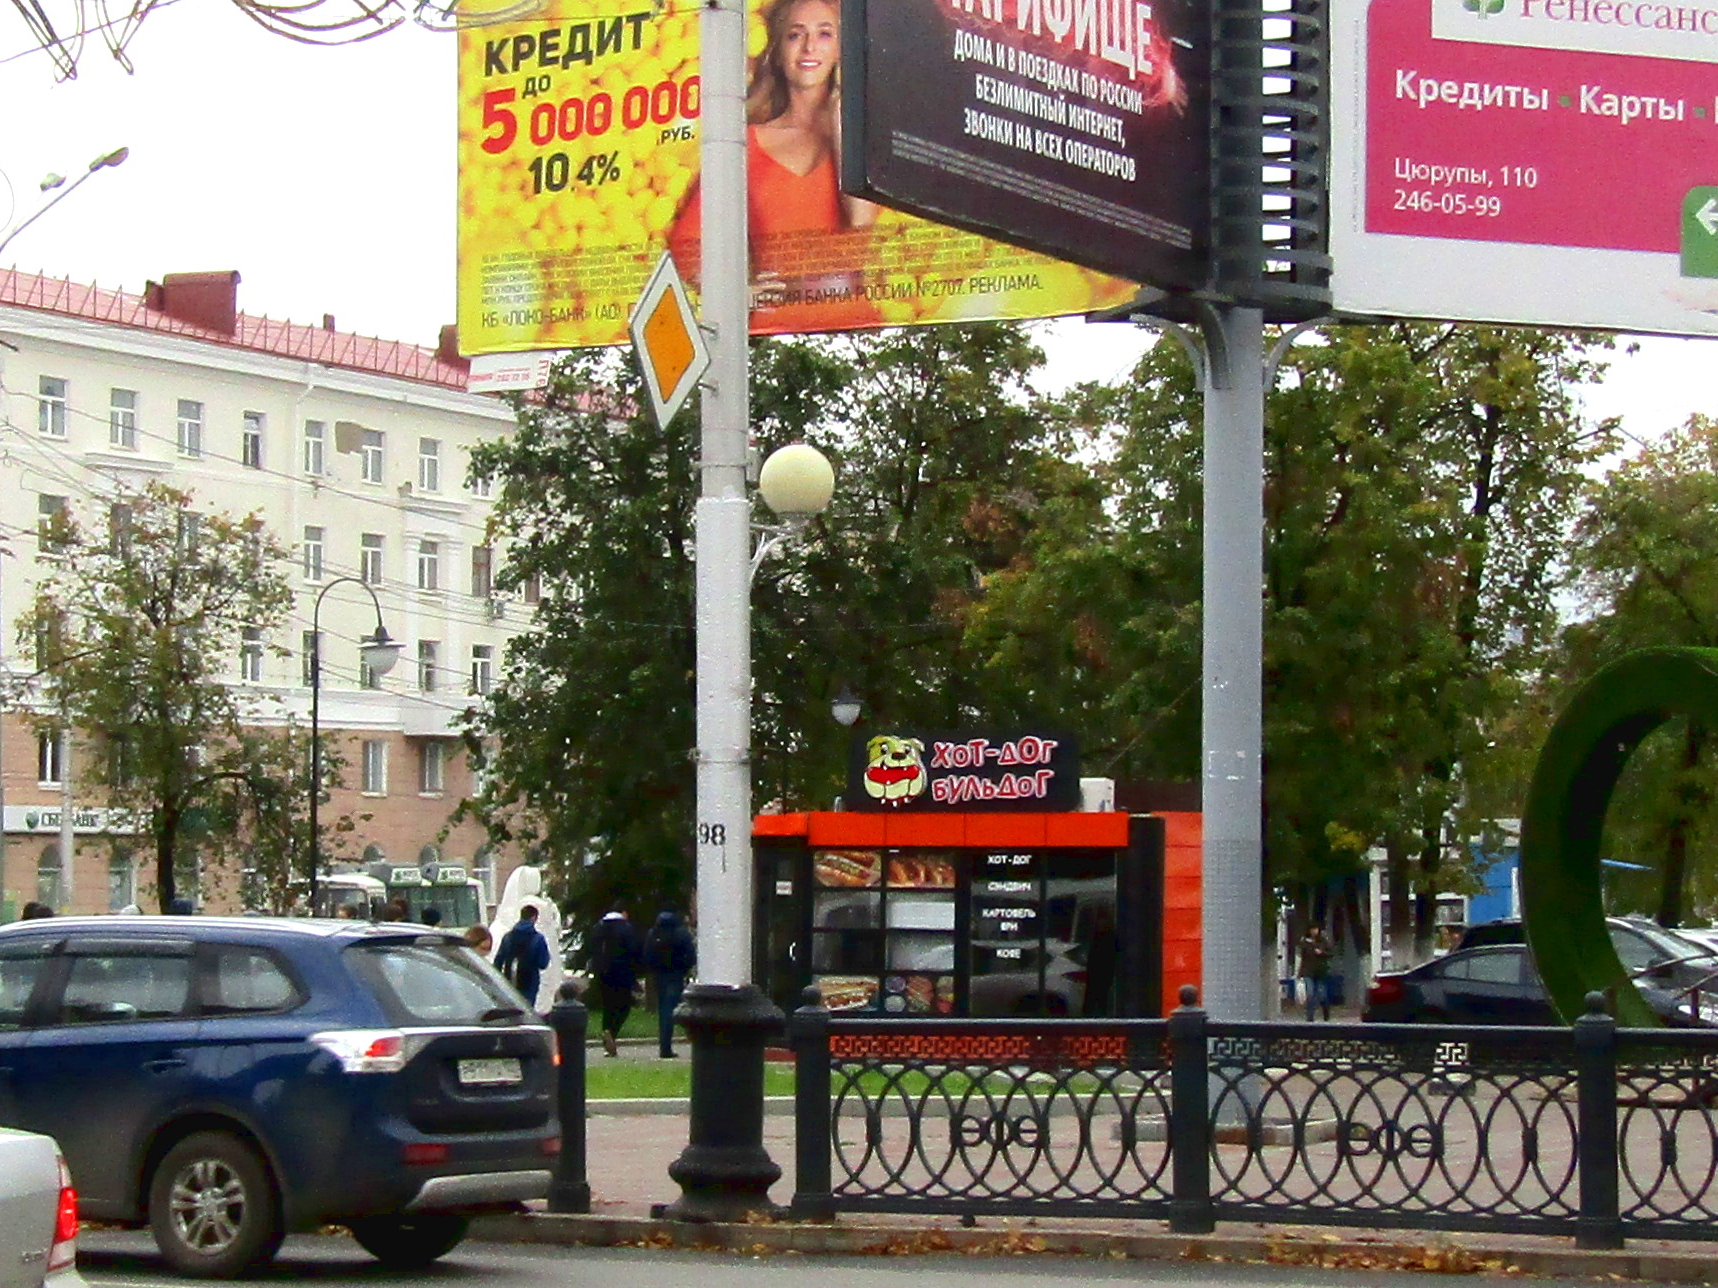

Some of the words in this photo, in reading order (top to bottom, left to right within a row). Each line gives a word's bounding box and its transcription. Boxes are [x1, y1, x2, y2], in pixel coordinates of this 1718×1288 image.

[483, 12, 651, 77] КРЕДИТ
[522, 74, 551, 99] ДО
[954, 29, 993, 64] ДОМА
[995, 43, 1005, 66] И
[1007, 47, 1016, 71] В
[1018, 51, 1080, 94] ПОЕЗДКАХ
[1081, 72, 1098, 100] ПО
[1100, 79, 1143, 114] РОССИИ
[975, 73, 1066, 126] БЕЗЛИМИТНЫЙ
[1068, 103, 1126, 148] ИНТЕРНЕТ,
[1394, 69, 1549, 111] Кредиты
[1579, 85, 1685, 125] Карты
[480, 87, 518, 154] 5
[530, 92, 612, 146] 000
[622, 75, 701, 130] 000
[964, 107, 1014, 147] ЗВОНКИ
[1016, 123, 1033, 152] НА
[1035, 129, 1063, 162] ВСЕХ
[1065, 139, 1137, 181] ОПЕРАТОРОВ
[1394, 157, 1493, 187] Цюрупы,
[1500, 165, 1538, 188] 110
[1393, 189, 1501, 218] 246-05-99
[805, 287, 852, 306] БАНКА
[856, 283, 914, 302] РОССИИ
[970, 274, 1044, 294] РЕКЛАМА.
[482, 311, 498, 328] КБ
[931, 736, 1058, 768] ХОТ-ДОГ
[932, 770, 1055, 804] БУЛЬДОГ
[698, 823, 726, 846] 98
